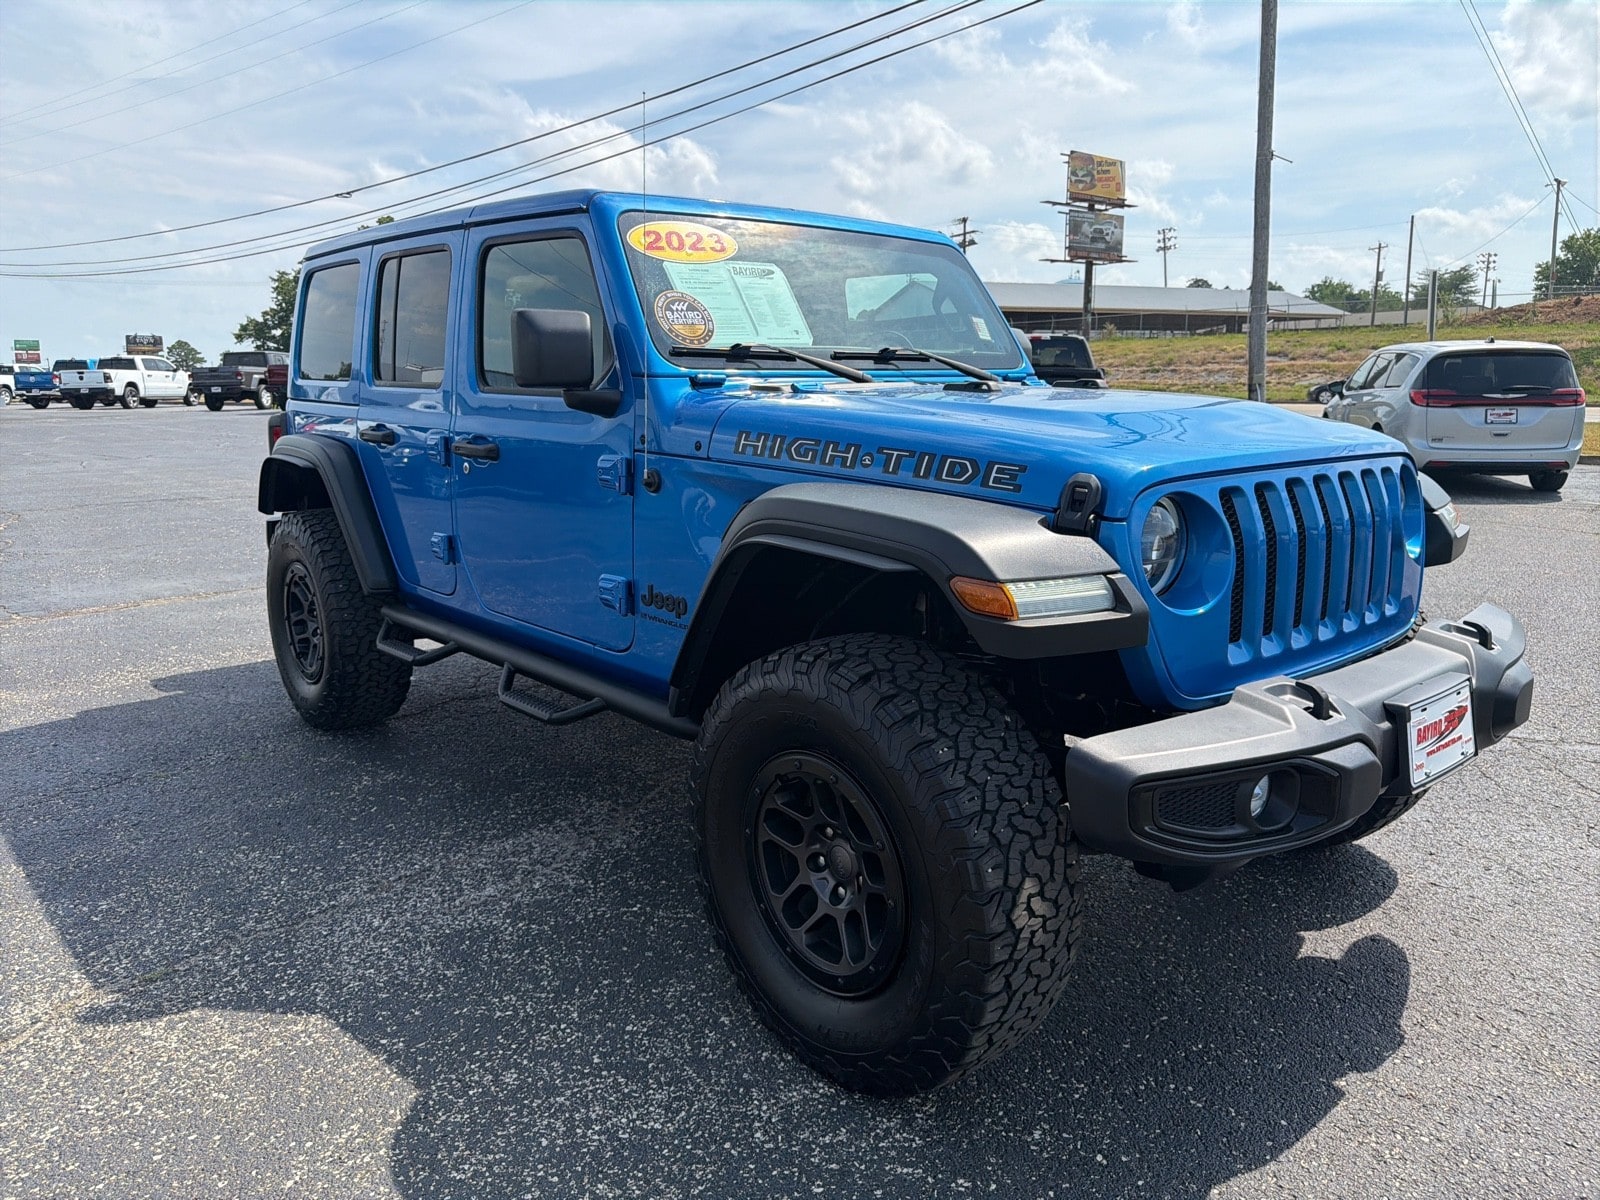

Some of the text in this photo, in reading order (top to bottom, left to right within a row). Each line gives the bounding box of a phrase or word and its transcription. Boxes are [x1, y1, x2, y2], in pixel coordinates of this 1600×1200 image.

[645, 230, 727, 252] 2023
[666, 311, 702, 319] BAYIRD
[734, 430, 1028, 493] HIGH TIDE
[641, 584, 688, 619] Jeep
[1417, 719, 1442, 745] BAYIRD
